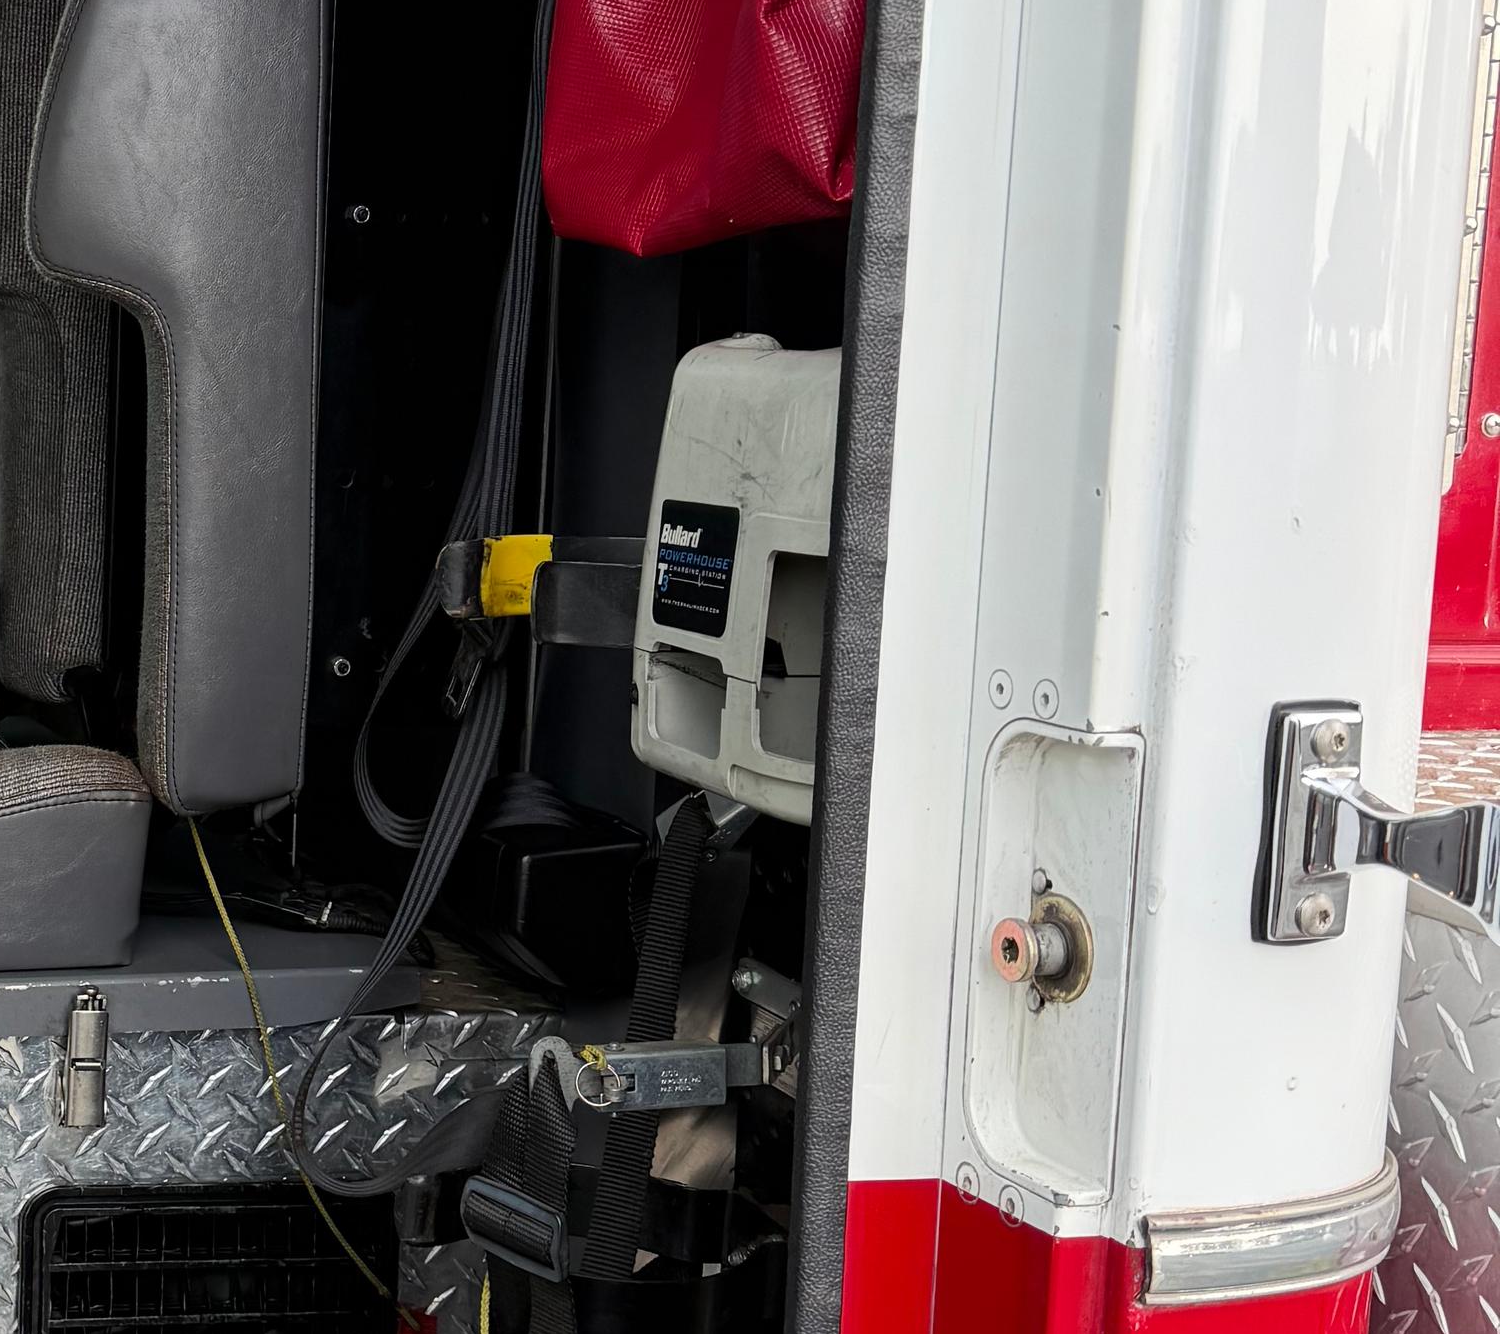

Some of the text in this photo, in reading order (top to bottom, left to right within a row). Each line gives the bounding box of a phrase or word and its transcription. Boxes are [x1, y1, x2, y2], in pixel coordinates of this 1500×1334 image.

[660, 523, 702, 548] Bullard
[659, 548, 730, 570] POWERHOUSE
[669, 564, 727, 580] CHARGING STATION
